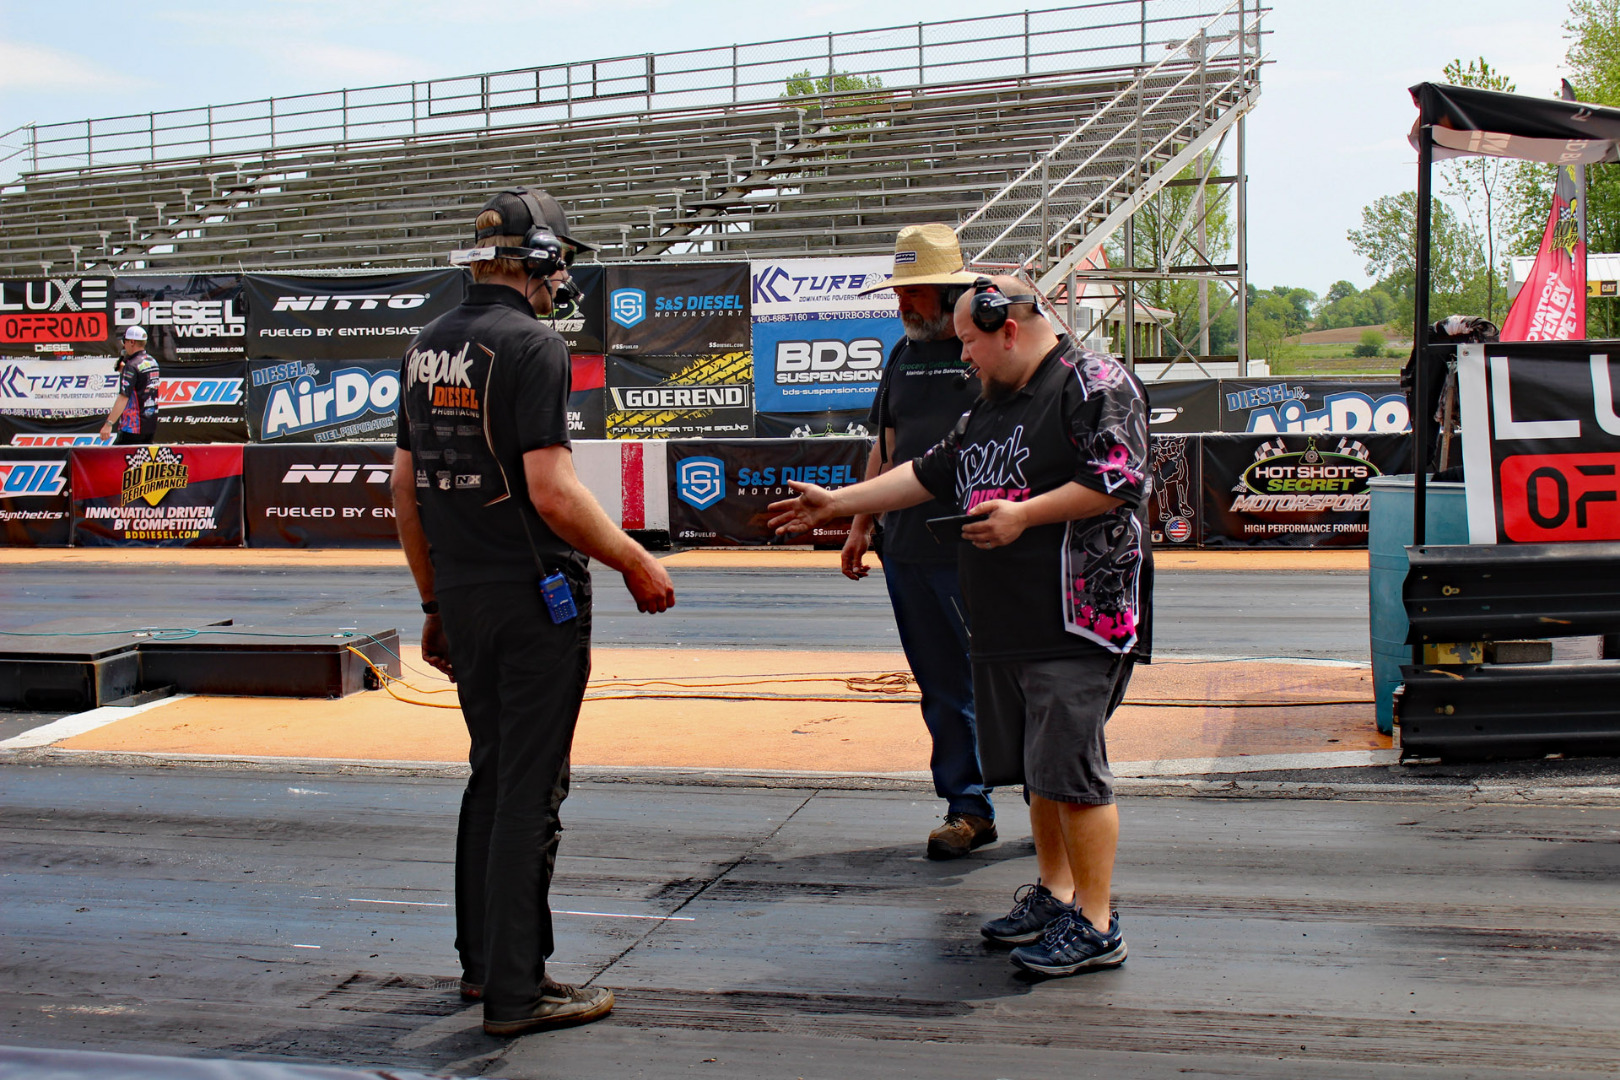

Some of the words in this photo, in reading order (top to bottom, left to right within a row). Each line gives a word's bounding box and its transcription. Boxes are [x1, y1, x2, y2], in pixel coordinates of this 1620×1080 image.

[753, 265, 792, 304] KC
[1601, 283, 1616, 293] CAT
[0, 278, 107, 312] LUXE
[272, 293, 426, 312] NITTO
[655, 296, 683, 311] S&S
[686, 295, 744, 310] DIESEL
[655, 309, 742, 317] MOTORSPORT
[757, 313, 807, 323] 480-688-7160
[818, 310, 898, 321] KCTURBOS.COM
[6, 317, 100, 339] OFFROAD
[175, 324, 245, 338] WORLD
[260, 328, 312, 337] FUELED
[317, 328, 334, 337] BY
[338, 327, 424, 336] ENTHUSIAS
[777, 339, 882, 372] BDS
[252, 360, 307, 387] DIESEL
[776, 369, 882, 384] SUSPENSION
[158, 381, 240, 402] MSOIL
[432, 386, 479, 410] DIESEL
[626, 387, 743, 407] GOEREND
[782, 386, 879, 396] bds-suspension.com
[1226, 383, 1294, 412] DIESEL
[266, 373, 399, 434] AirDo
[173, 415, 183, 423] in
[184, 415, 239, 425] Synthetics
[314, 429, 341, 443] FUEL
[629, 426, 651, 434] YOUR
[653, 426, 680, 435] POWER
[695, 425, 713, 433] THE
[714, 423, 749, 432] GROUND
[123, 467, 142, 491] BD
[145, 463, 188, 483] DIESEL
[281, 464, 395, 484] NIT
[737, 466, 776, 487] S&S
[781, 465, 857, 486] DIESEL
[1255, 466, 1296, 479] HOT
[1296, 466, 1368, 479] SHOT'S
[121, 478, 188, 507] PERFORMANCE
[1266, 479, 1354, 492] SECRET
[85, 507, 164, 519] INNOVATION
[166, 506, 214, 518] DRIVEN
[265, 507, 336, 518] FUELED
[342, 507, 367, 518] BY
[113, 518, 131, 530] BY
[133, 517, 217, 530] COMPETITION.
[1244, 524, 1266, 533] HIGH
[1267, 524, 1331, 533] PERFORMANCE
[1332, 524, 1369, 533] FORMUL
[125, 530, 200, 539] BDDIESEL.COM
[679, 530, 717, 538] #SSFUELED
